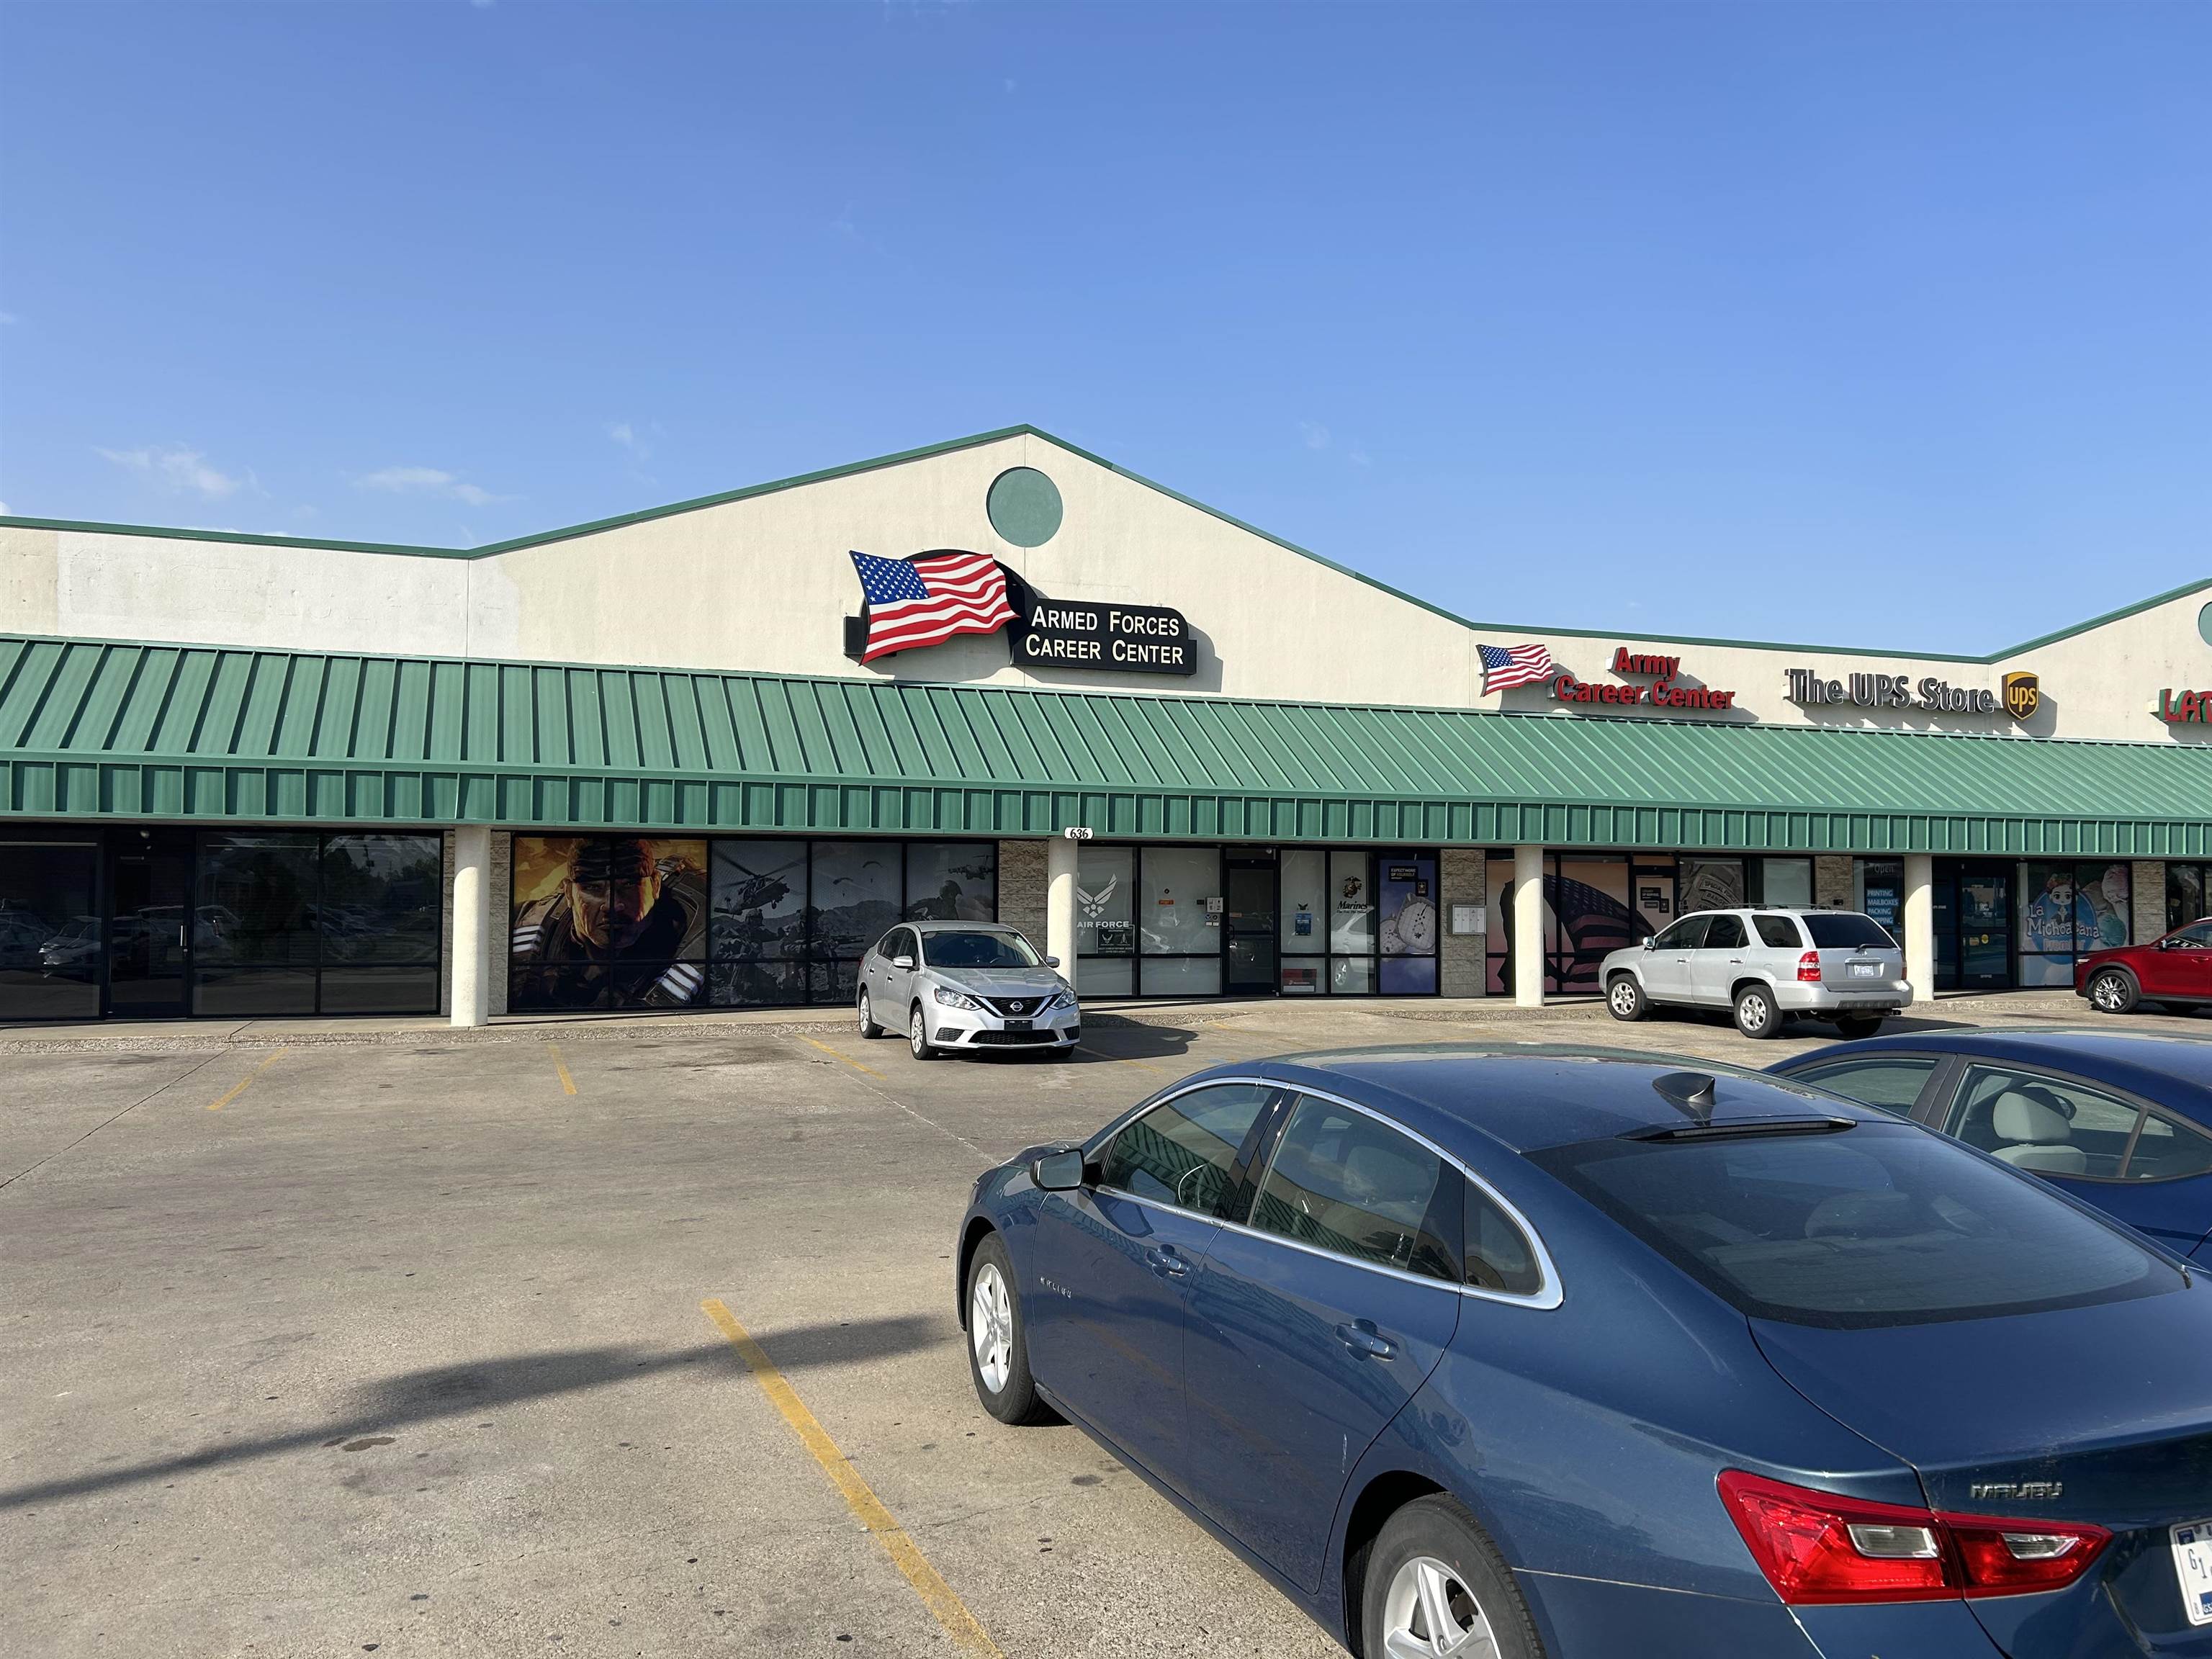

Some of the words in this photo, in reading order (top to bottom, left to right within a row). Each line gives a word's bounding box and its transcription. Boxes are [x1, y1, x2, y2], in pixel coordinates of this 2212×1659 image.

[1031, 606, 1098, 631] ARMED
[1110, 611, 1179, 637] FORCES
[1025, 634, 1102, 660] CAREER
[1112, 639, 1184, 665] CENTER
[1614, 647, 1681, 681] Army
[1555, 675, 1645, 705] Career
[1650, 681, 1735, 709] Center
[1785, 668, 1843, 704] The
[1849, 672, 1912, 709] UPS
[1917, 678, 1995, 713] Store
[2010, 686, 2036, 712] ups
[1070, 829, 1089, 839] 636
[1337, 901, 1367, 909] Marines
